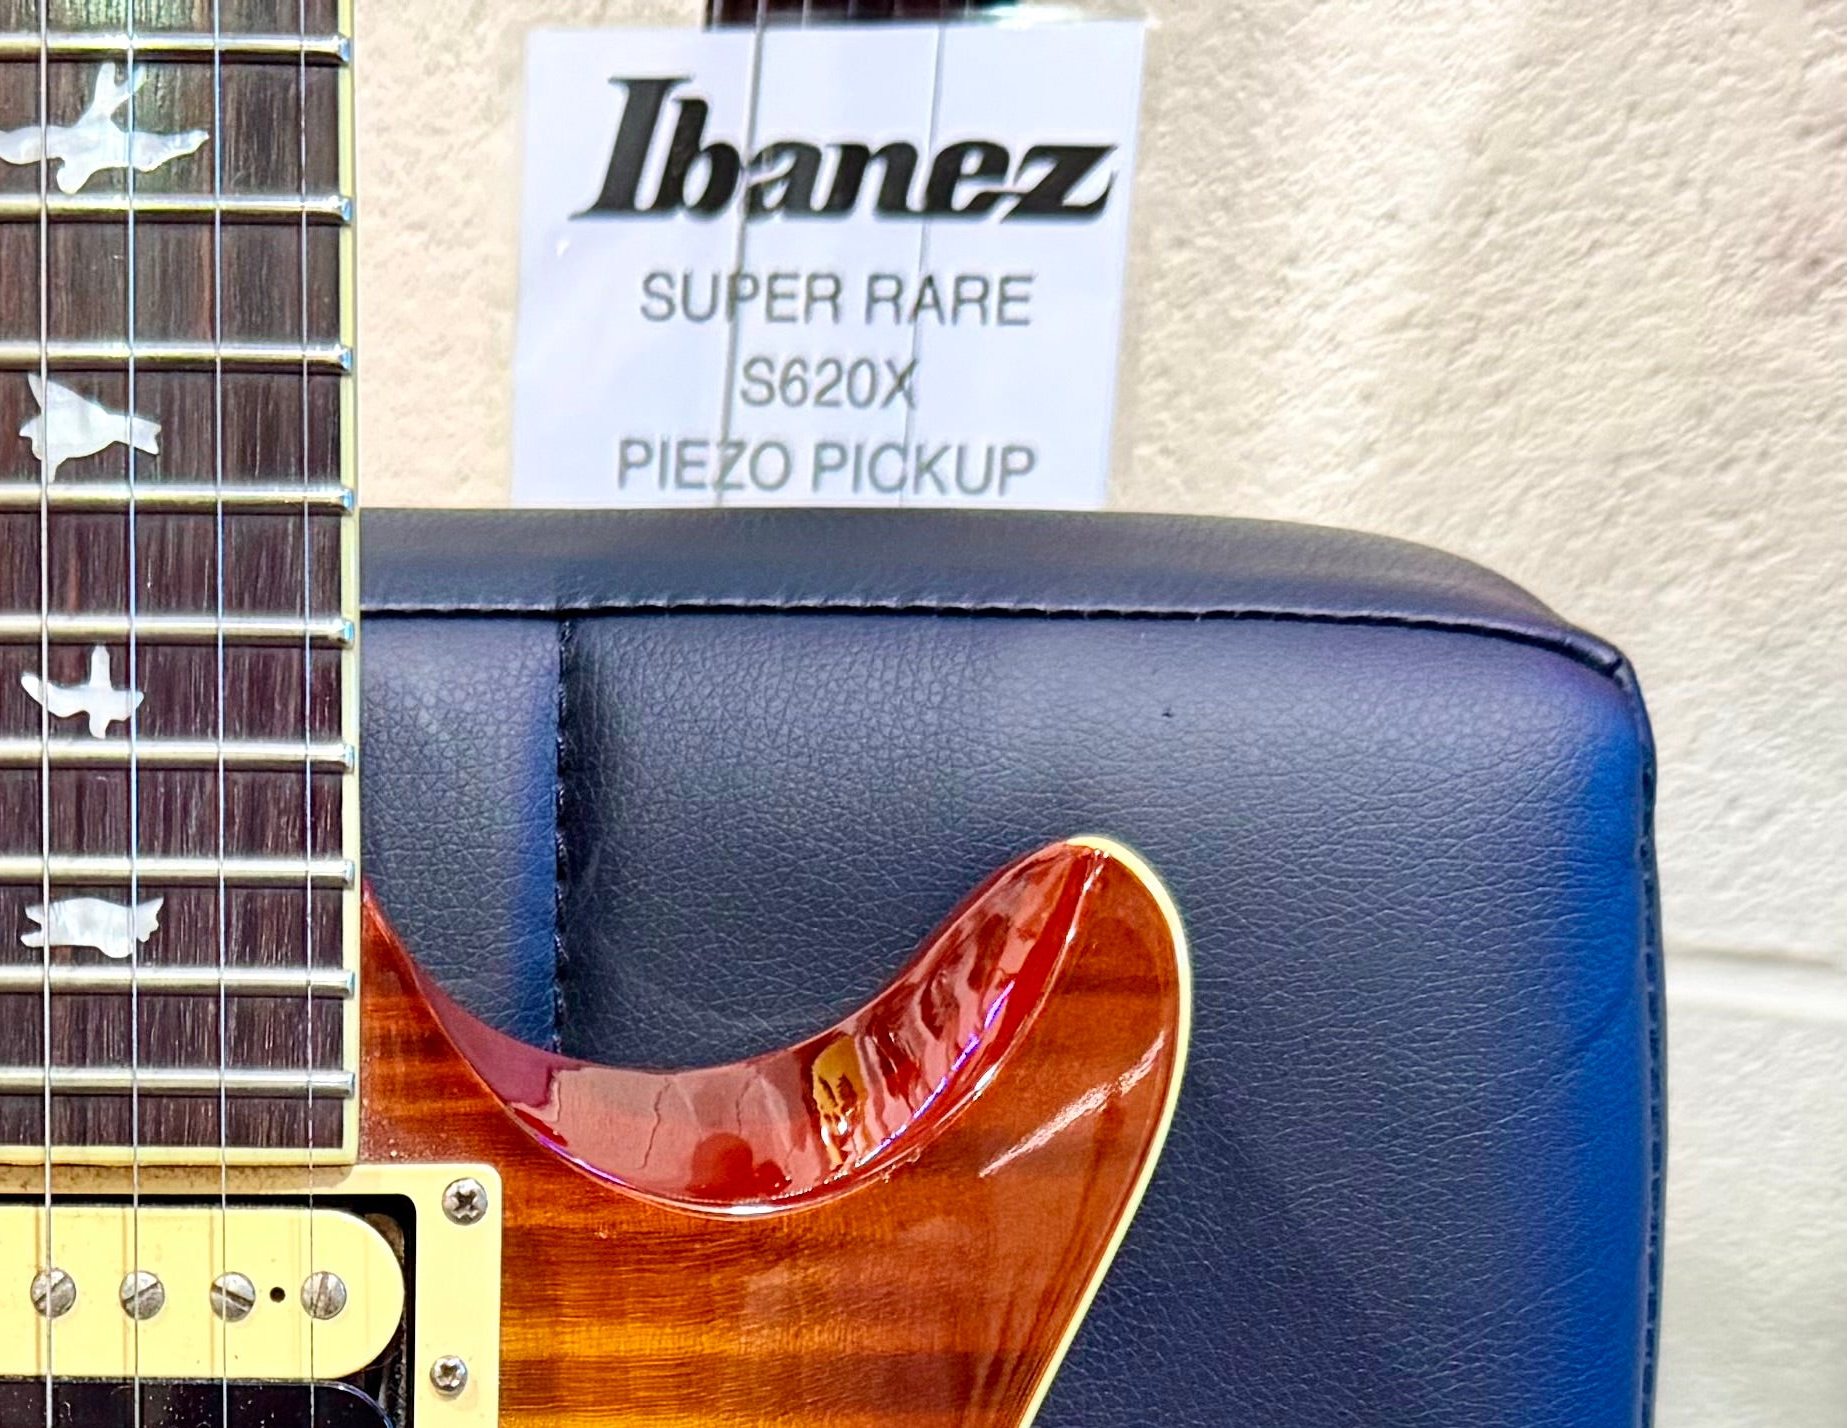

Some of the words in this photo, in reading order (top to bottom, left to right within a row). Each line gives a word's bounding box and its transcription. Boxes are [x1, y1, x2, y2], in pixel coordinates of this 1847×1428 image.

[568, 74, 1118, 225] Ibanez
[640, 272, 843, 324] SUPER
[864, 273, 1035, 327] RARE
[739, 357, 919, 410] S620X
[617, 438, 793, 491] PIEZO
[812, 443, 1038, 496] PICKUP
